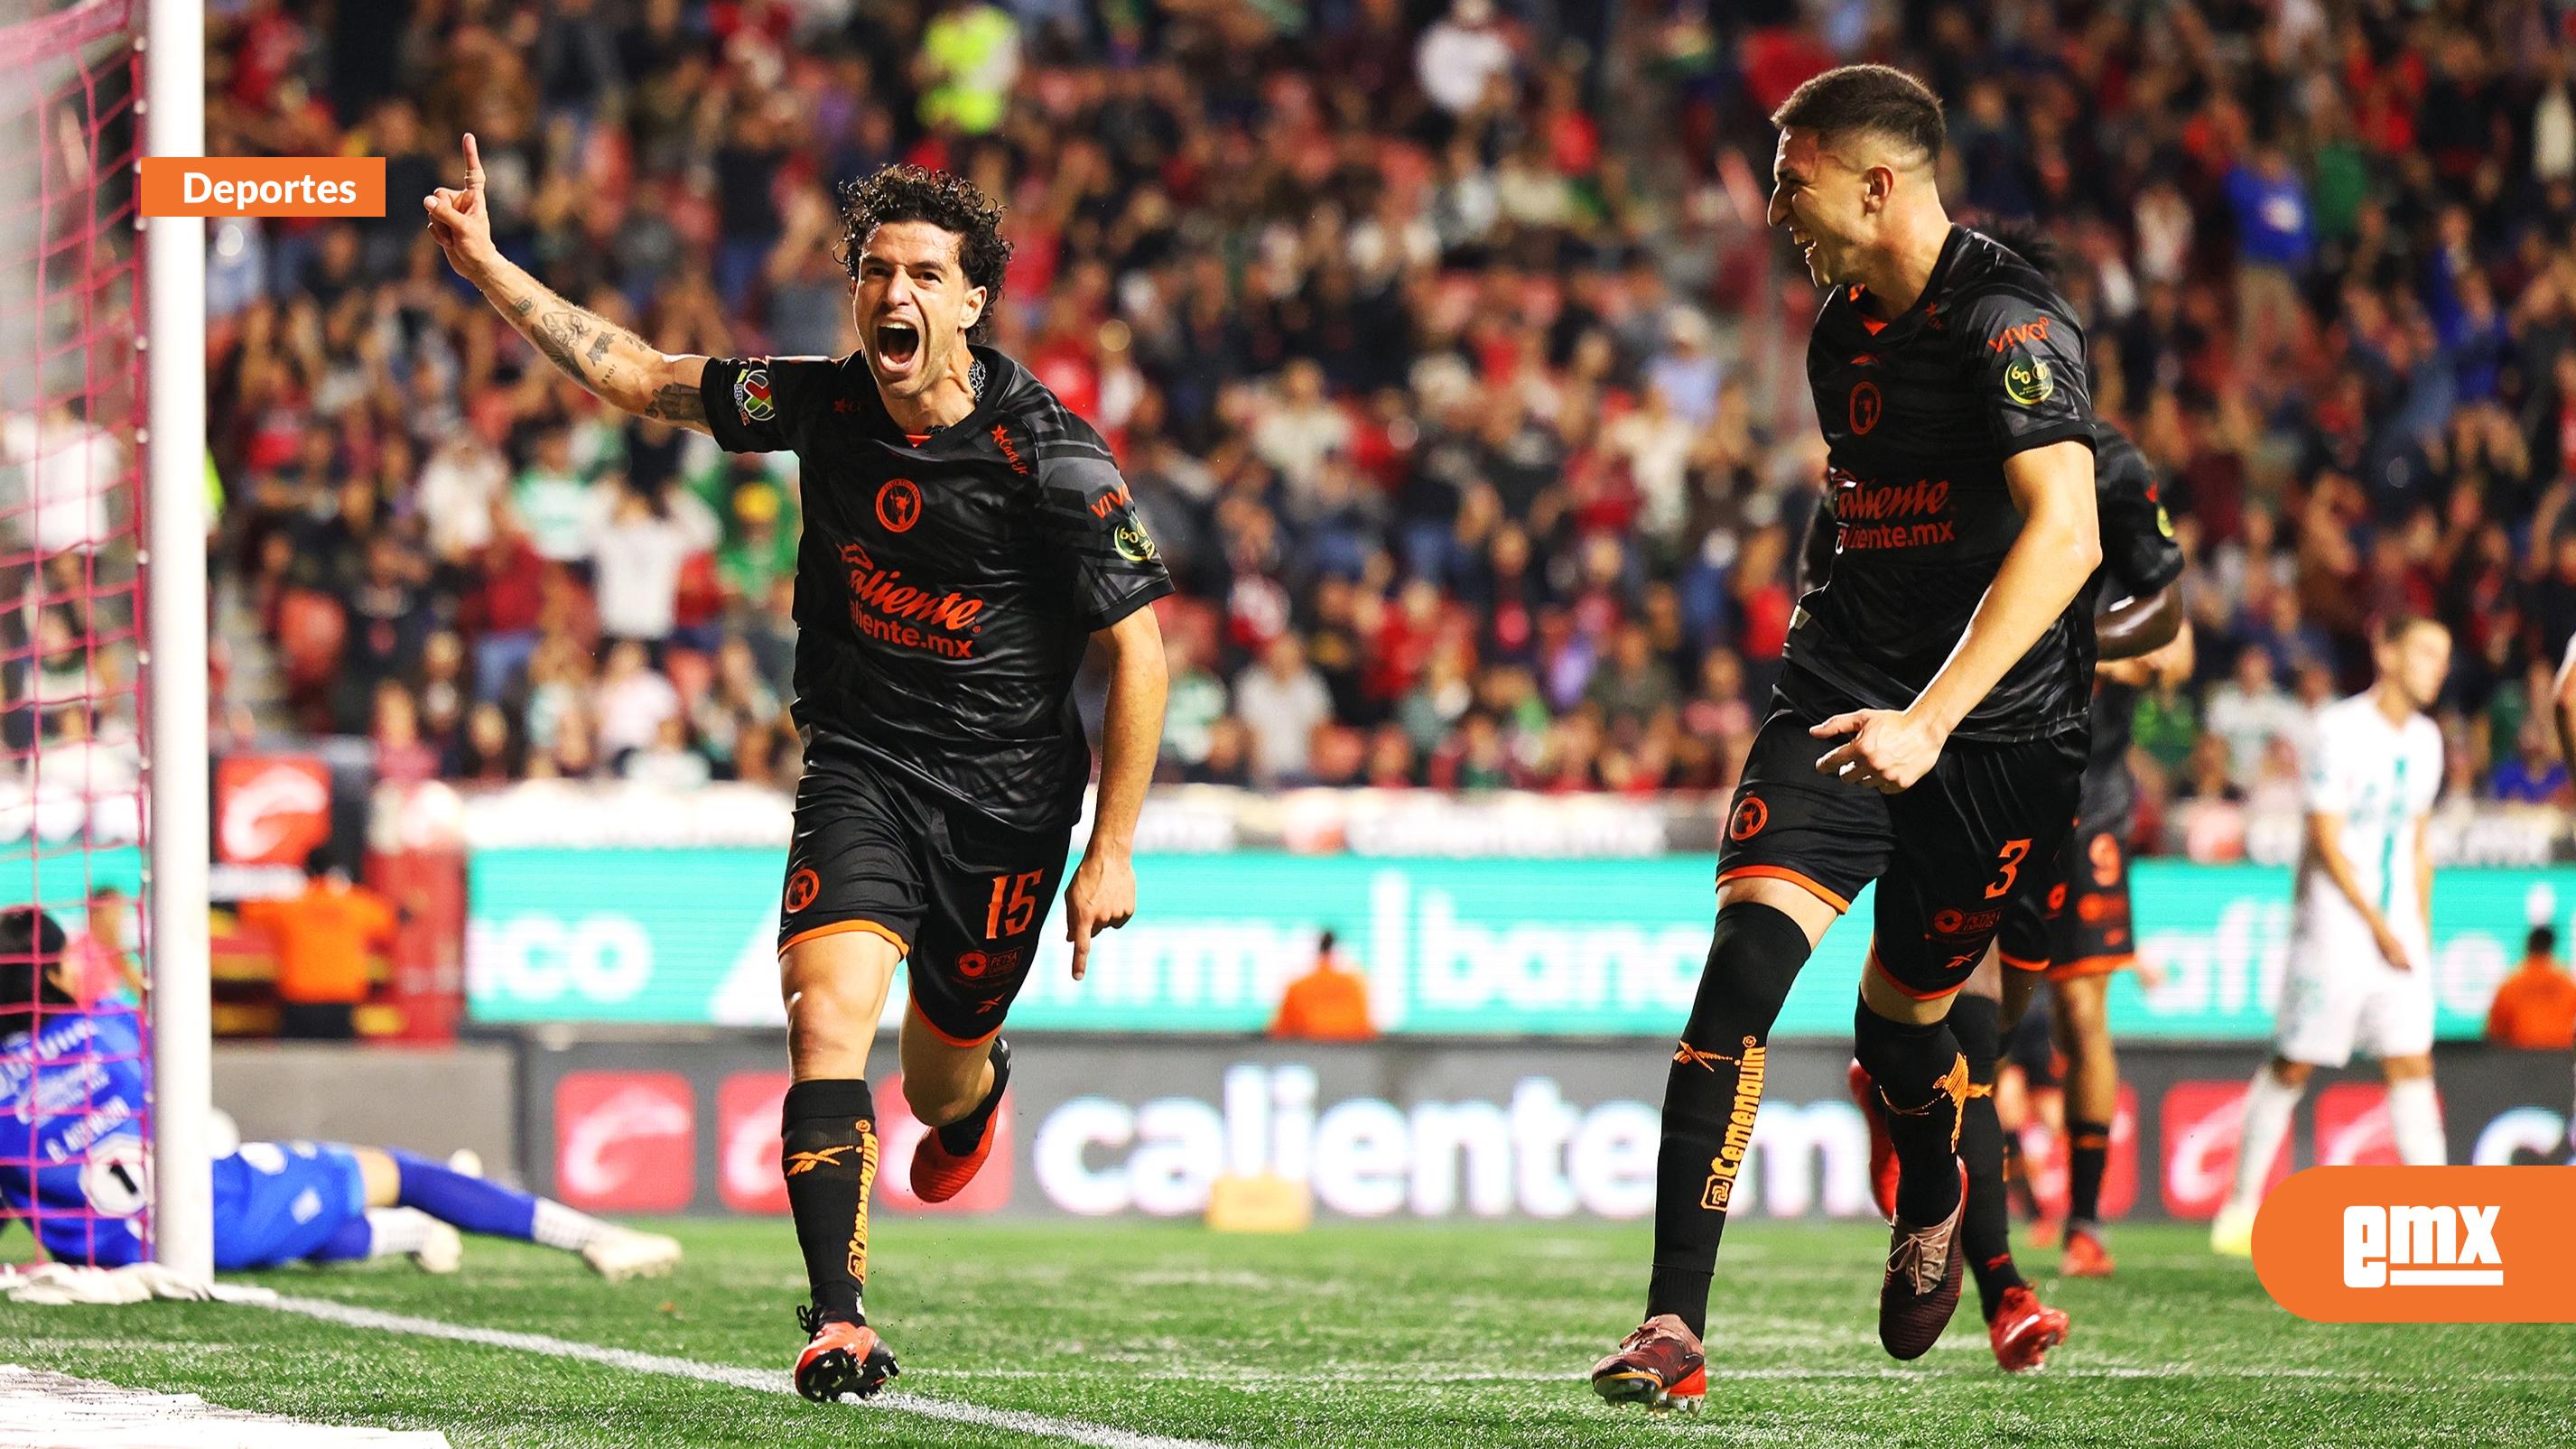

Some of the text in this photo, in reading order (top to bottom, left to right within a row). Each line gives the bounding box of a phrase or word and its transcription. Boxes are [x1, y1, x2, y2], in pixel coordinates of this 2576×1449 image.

[1837, 521, 1956, 550] aliente.mx
[851, 600, 973, 658] aliente.mx
[1984, 838, 2032, 900] 3
[985, 868, 1045, 940] 15
[1420, 885, 1716, 1009] banc
[109, 1160, 138, 1195] 1
